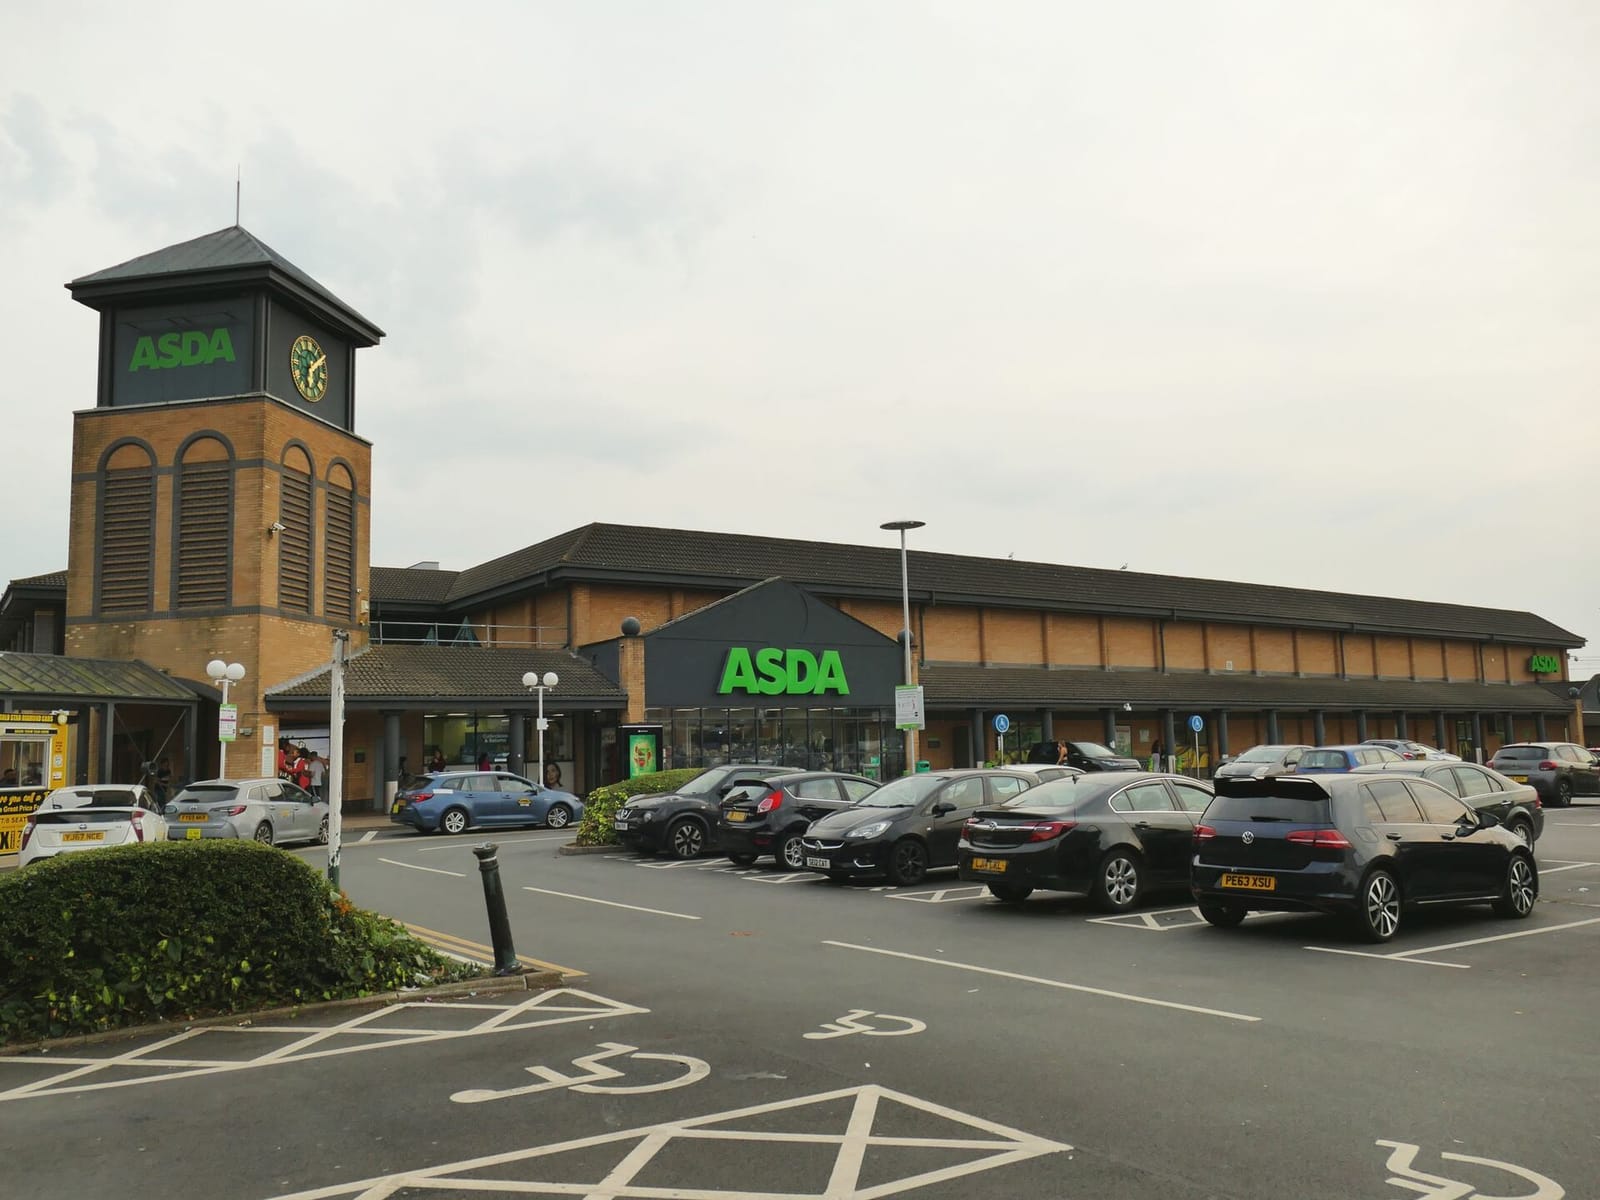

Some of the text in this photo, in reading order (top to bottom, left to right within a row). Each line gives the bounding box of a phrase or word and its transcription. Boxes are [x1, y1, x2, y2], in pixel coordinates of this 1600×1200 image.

[128, 327, 236, 372] ASDA
[718, 647, 850, 695] ASDA
[1531, 655, 1560, 672] ASDA
[1225, 875, 1272, 888] PE63 XSU
